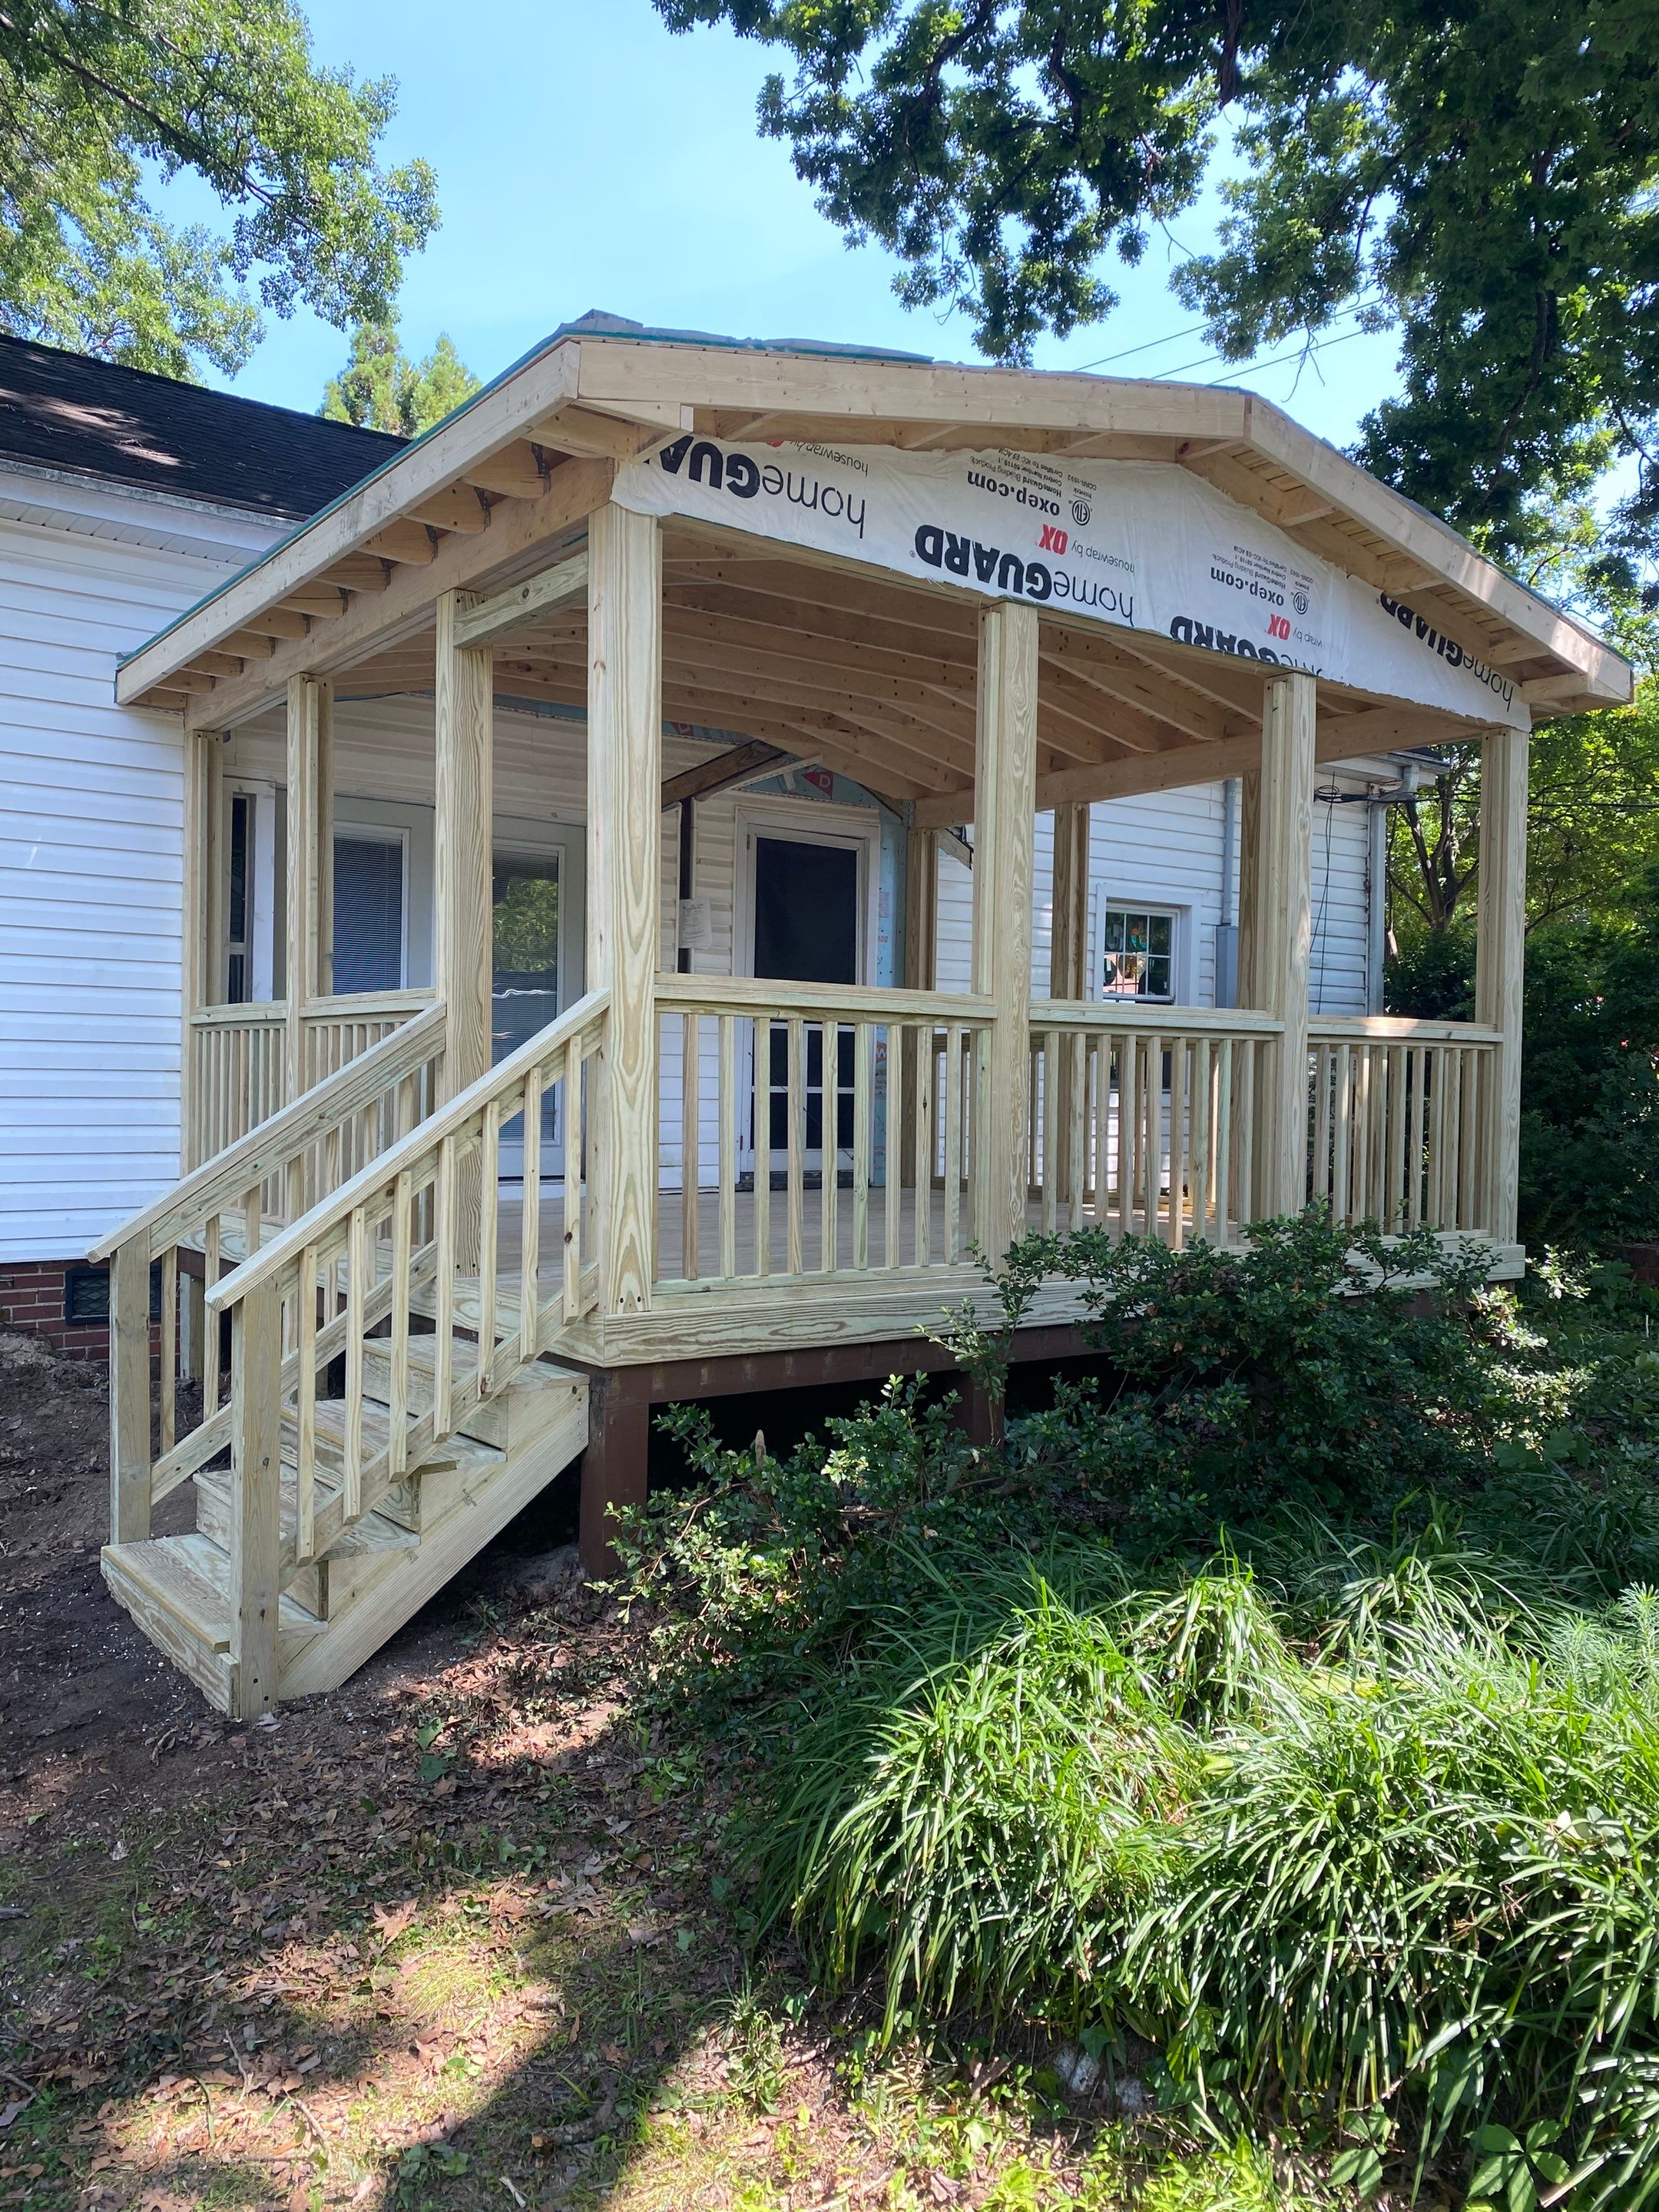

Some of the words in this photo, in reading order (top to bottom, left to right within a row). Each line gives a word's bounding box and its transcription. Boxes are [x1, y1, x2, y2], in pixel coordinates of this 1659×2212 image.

[806, 442, 868, 478] housewrap
[998, 465, 1022, 482] Building
[1041, 464, 1063, 477] Certified
[1022, 476, 1061, 498] HomeGuard
[1045, 477, 1062, 487] Control
[968, 470, 1060, 515] oxep.com
[1038, 524, 1069, 555] OX
[1071, 540, 1084, 552] by
[1211, 567, 1284, 606] oxep.com
[1255, 571, 1286, 590] HomeGuard
[1267, 614, 1291, 641] OX
[1293, 628, 1303, 639] by
